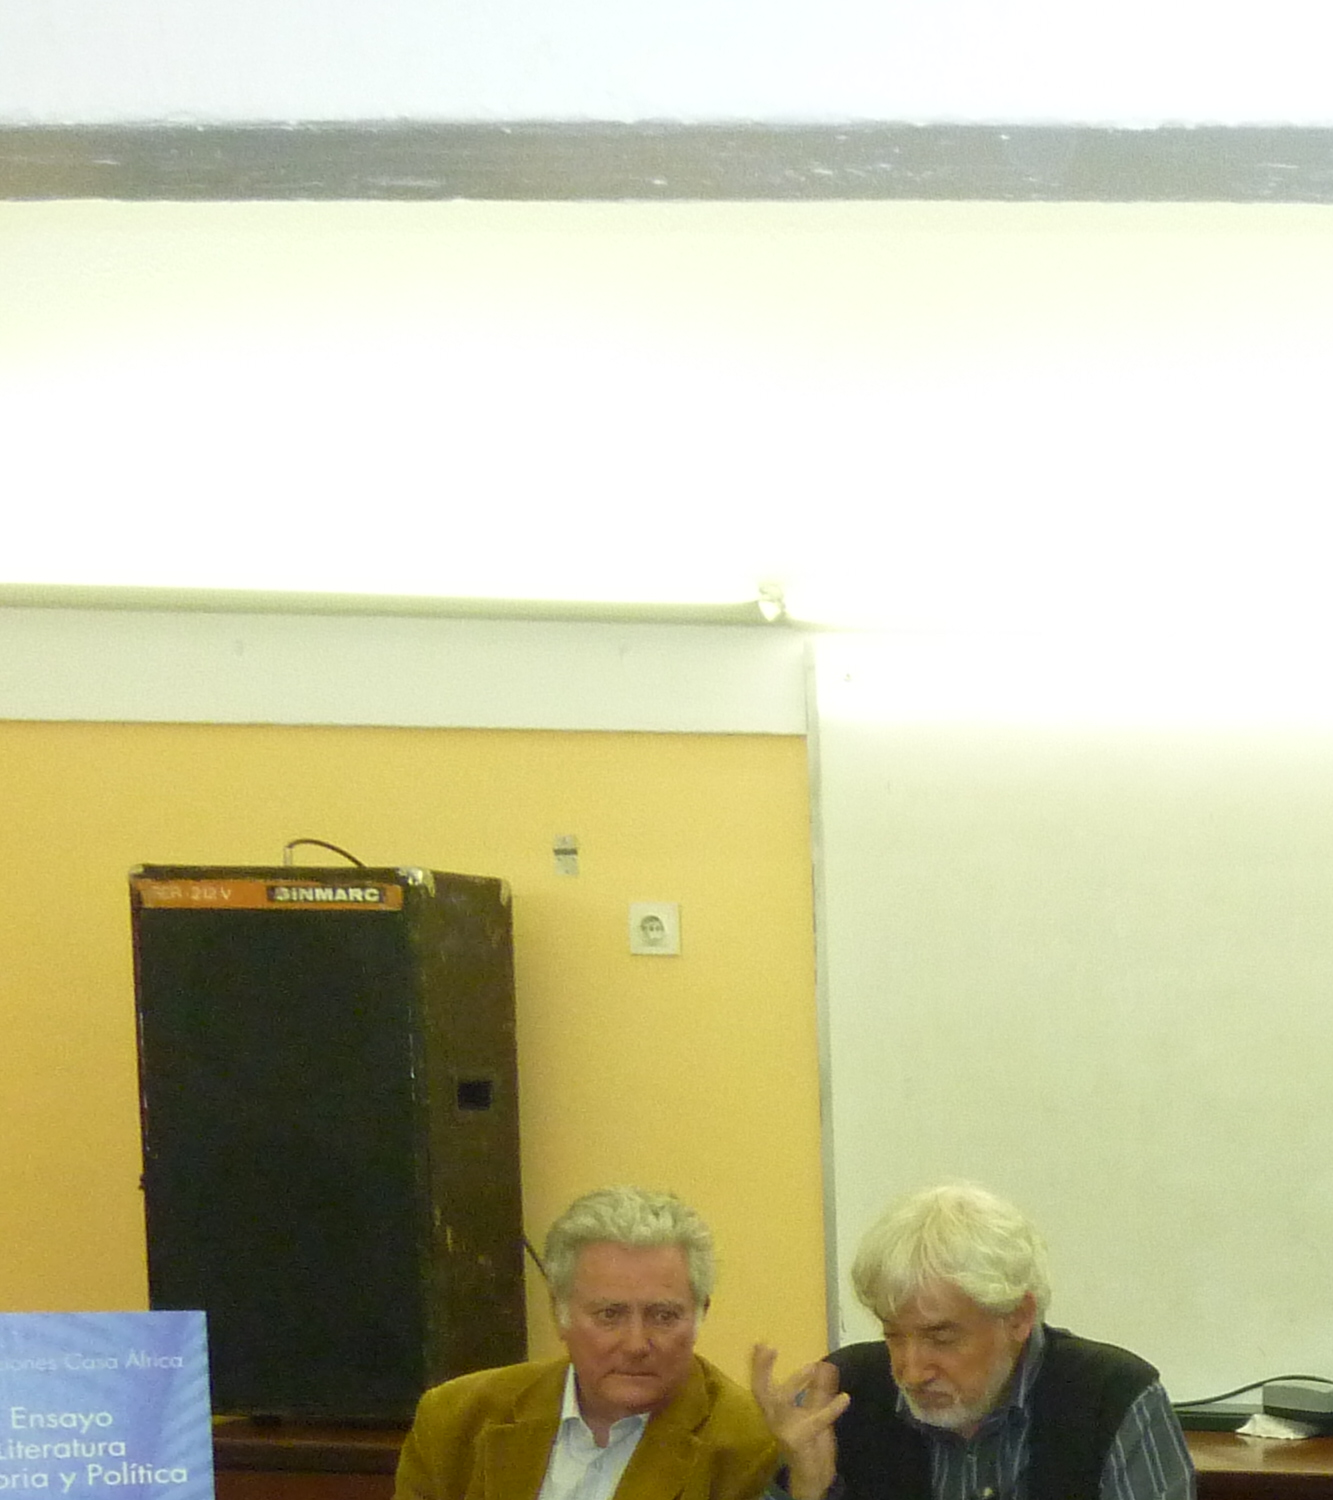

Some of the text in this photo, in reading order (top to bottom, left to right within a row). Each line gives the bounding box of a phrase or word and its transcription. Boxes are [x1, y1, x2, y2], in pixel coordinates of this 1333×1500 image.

[275, 887, 380, 902] SINMARC
[64, 1353, 119, 1370] Casa
[11, 1406, 114, 1434] Ensayo
[60, 1471, 77, 1494] y
[87, 1461, 189, 1486] Política
